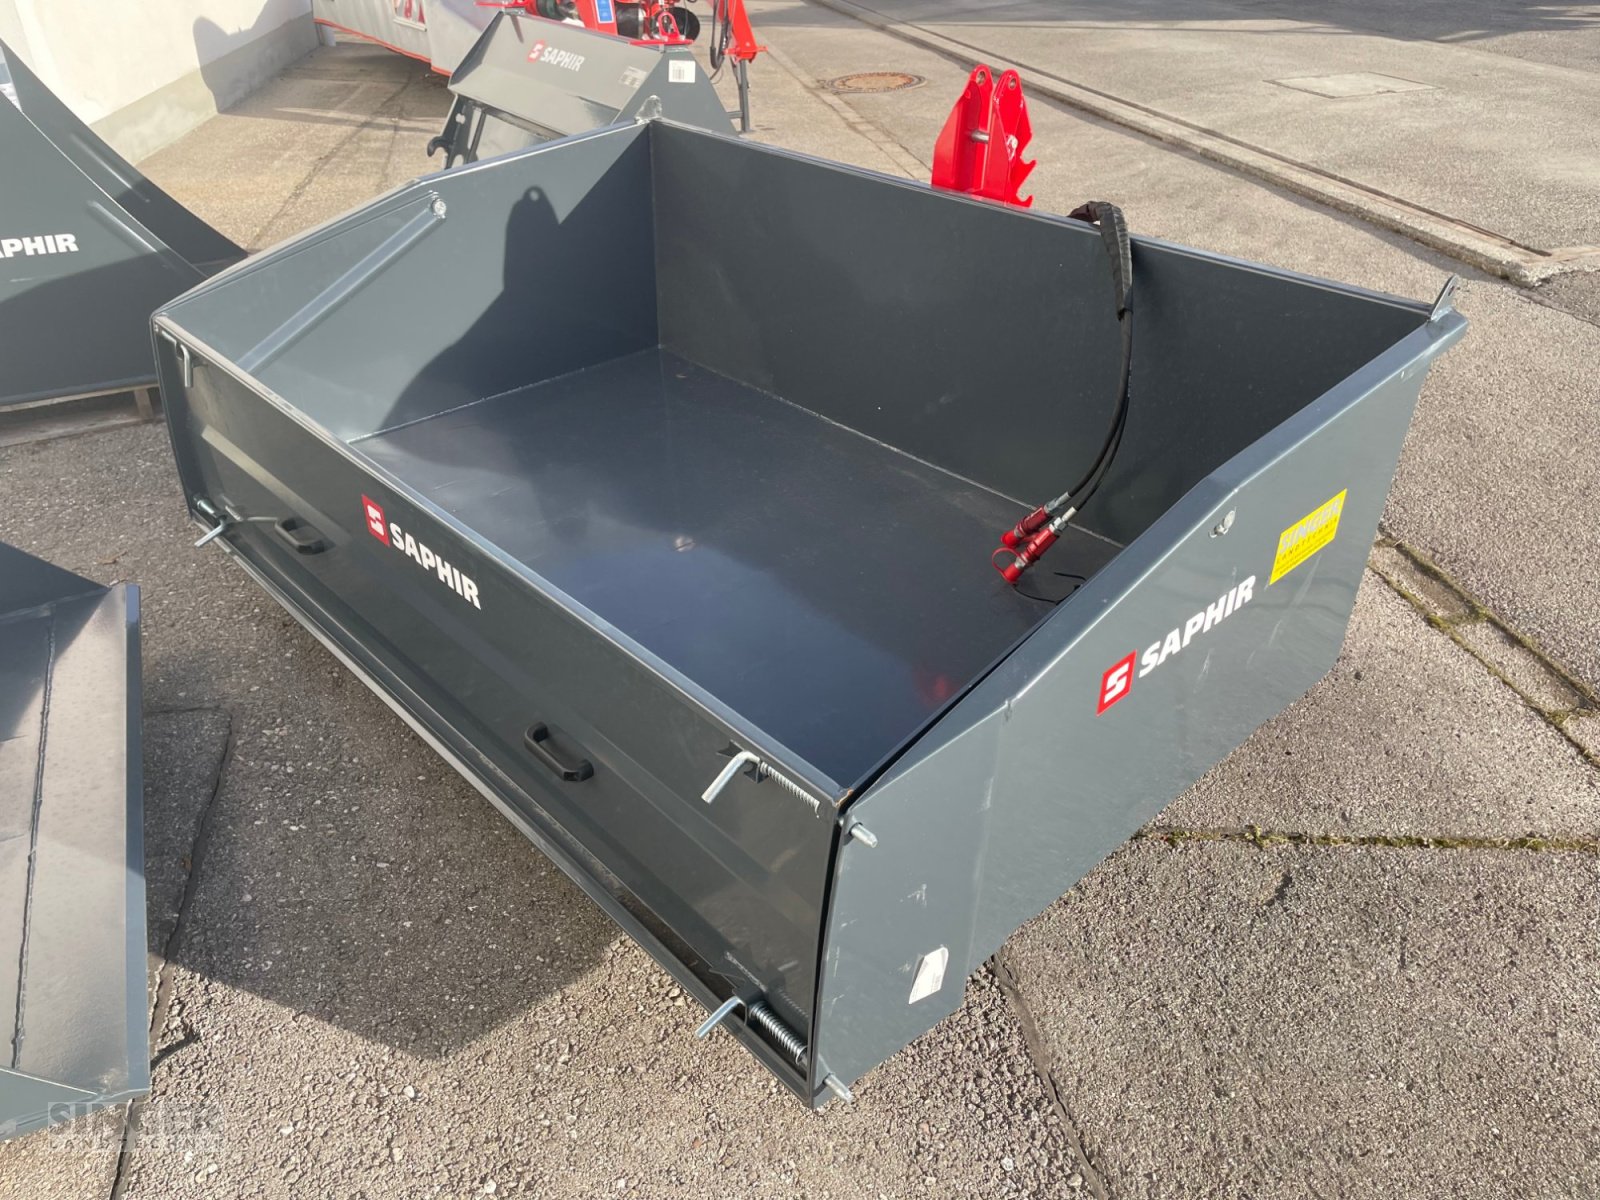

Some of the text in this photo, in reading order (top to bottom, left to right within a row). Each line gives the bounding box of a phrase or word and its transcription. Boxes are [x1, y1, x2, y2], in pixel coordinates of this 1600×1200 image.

[540, 46, 585, 72] SAPHIR
[0, 233, 79, 259] PHIR
[389, 522, 482, 610] SAPHIR
[1138, 574, 1257, 679] SAPHIR
